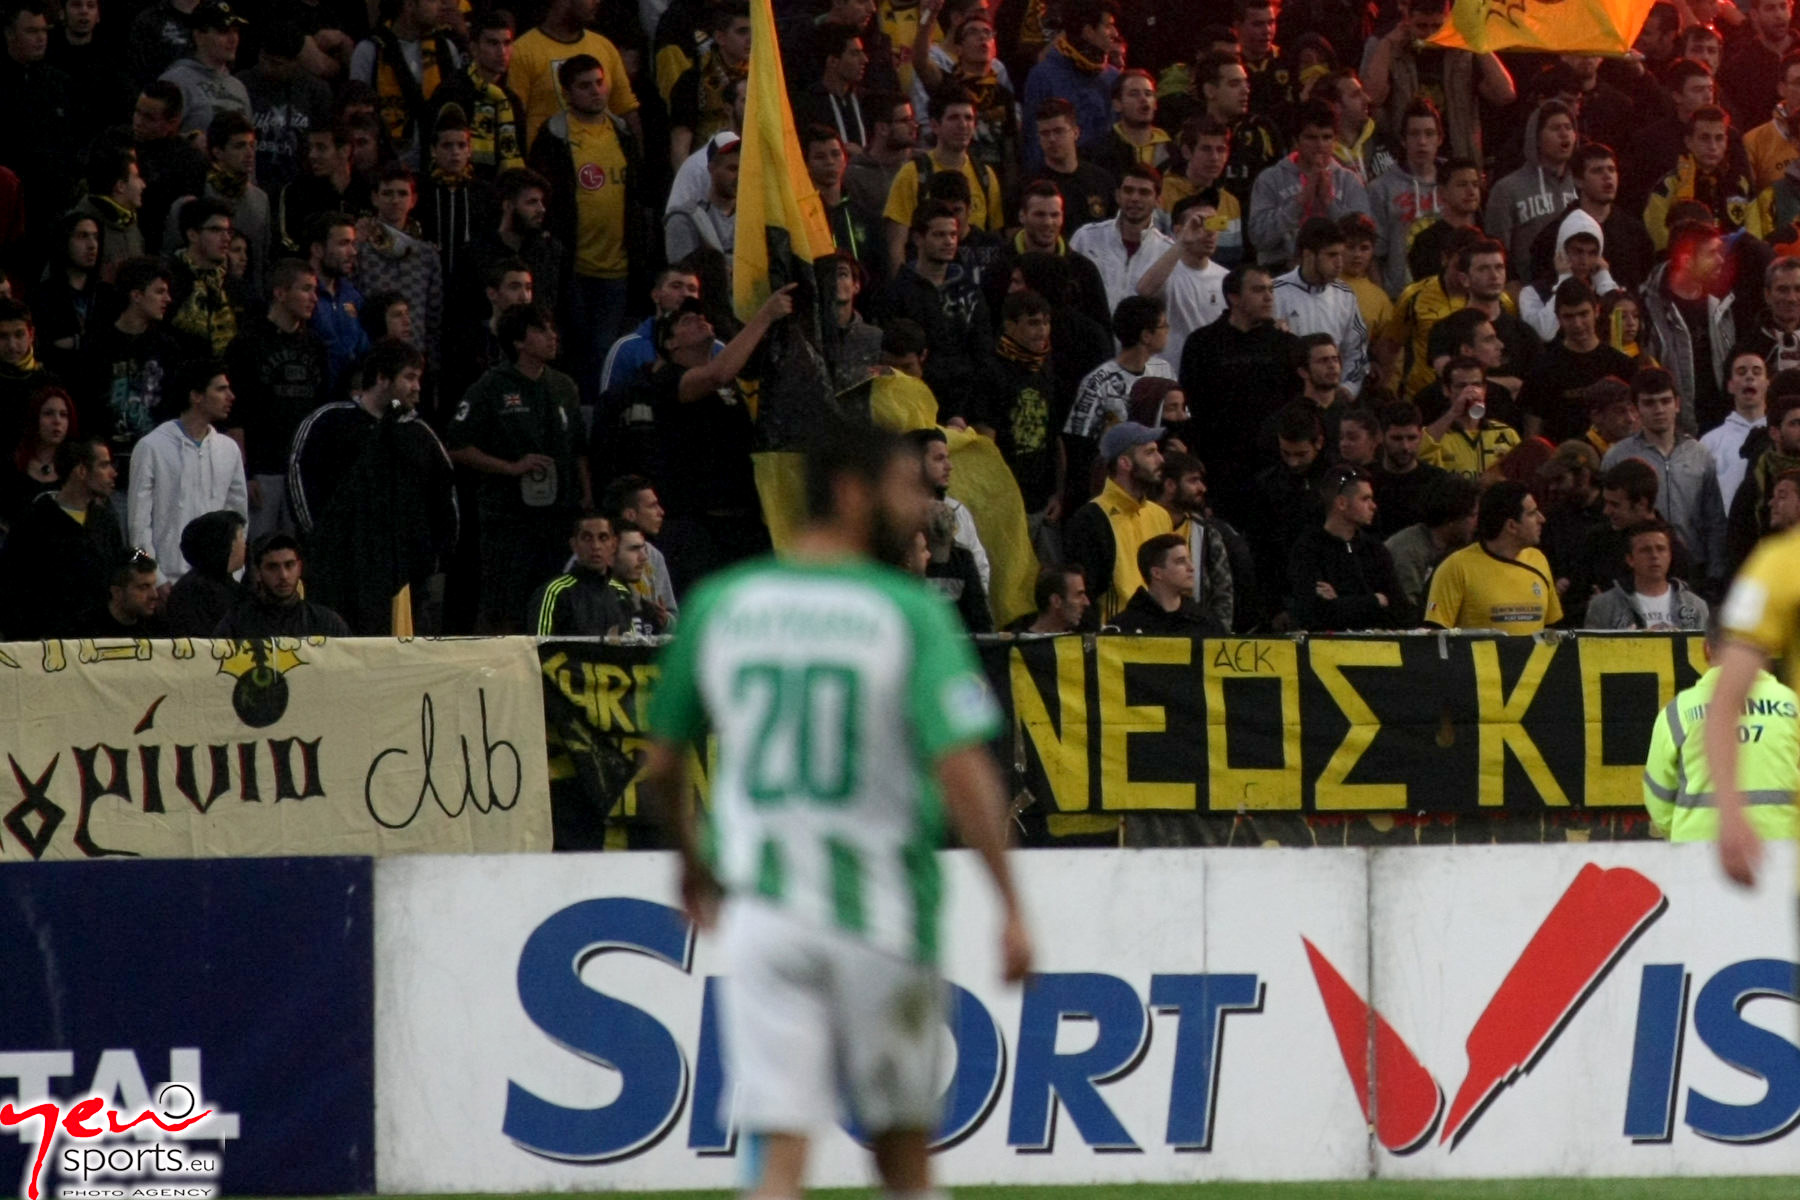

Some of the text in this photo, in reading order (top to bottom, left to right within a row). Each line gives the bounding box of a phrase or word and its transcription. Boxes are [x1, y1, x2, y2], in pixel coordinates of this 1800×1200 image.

[365, 687, 522, 829] club
[730, 658, 862, 808] 20
[503, 896, 1266, 1166] SORT
